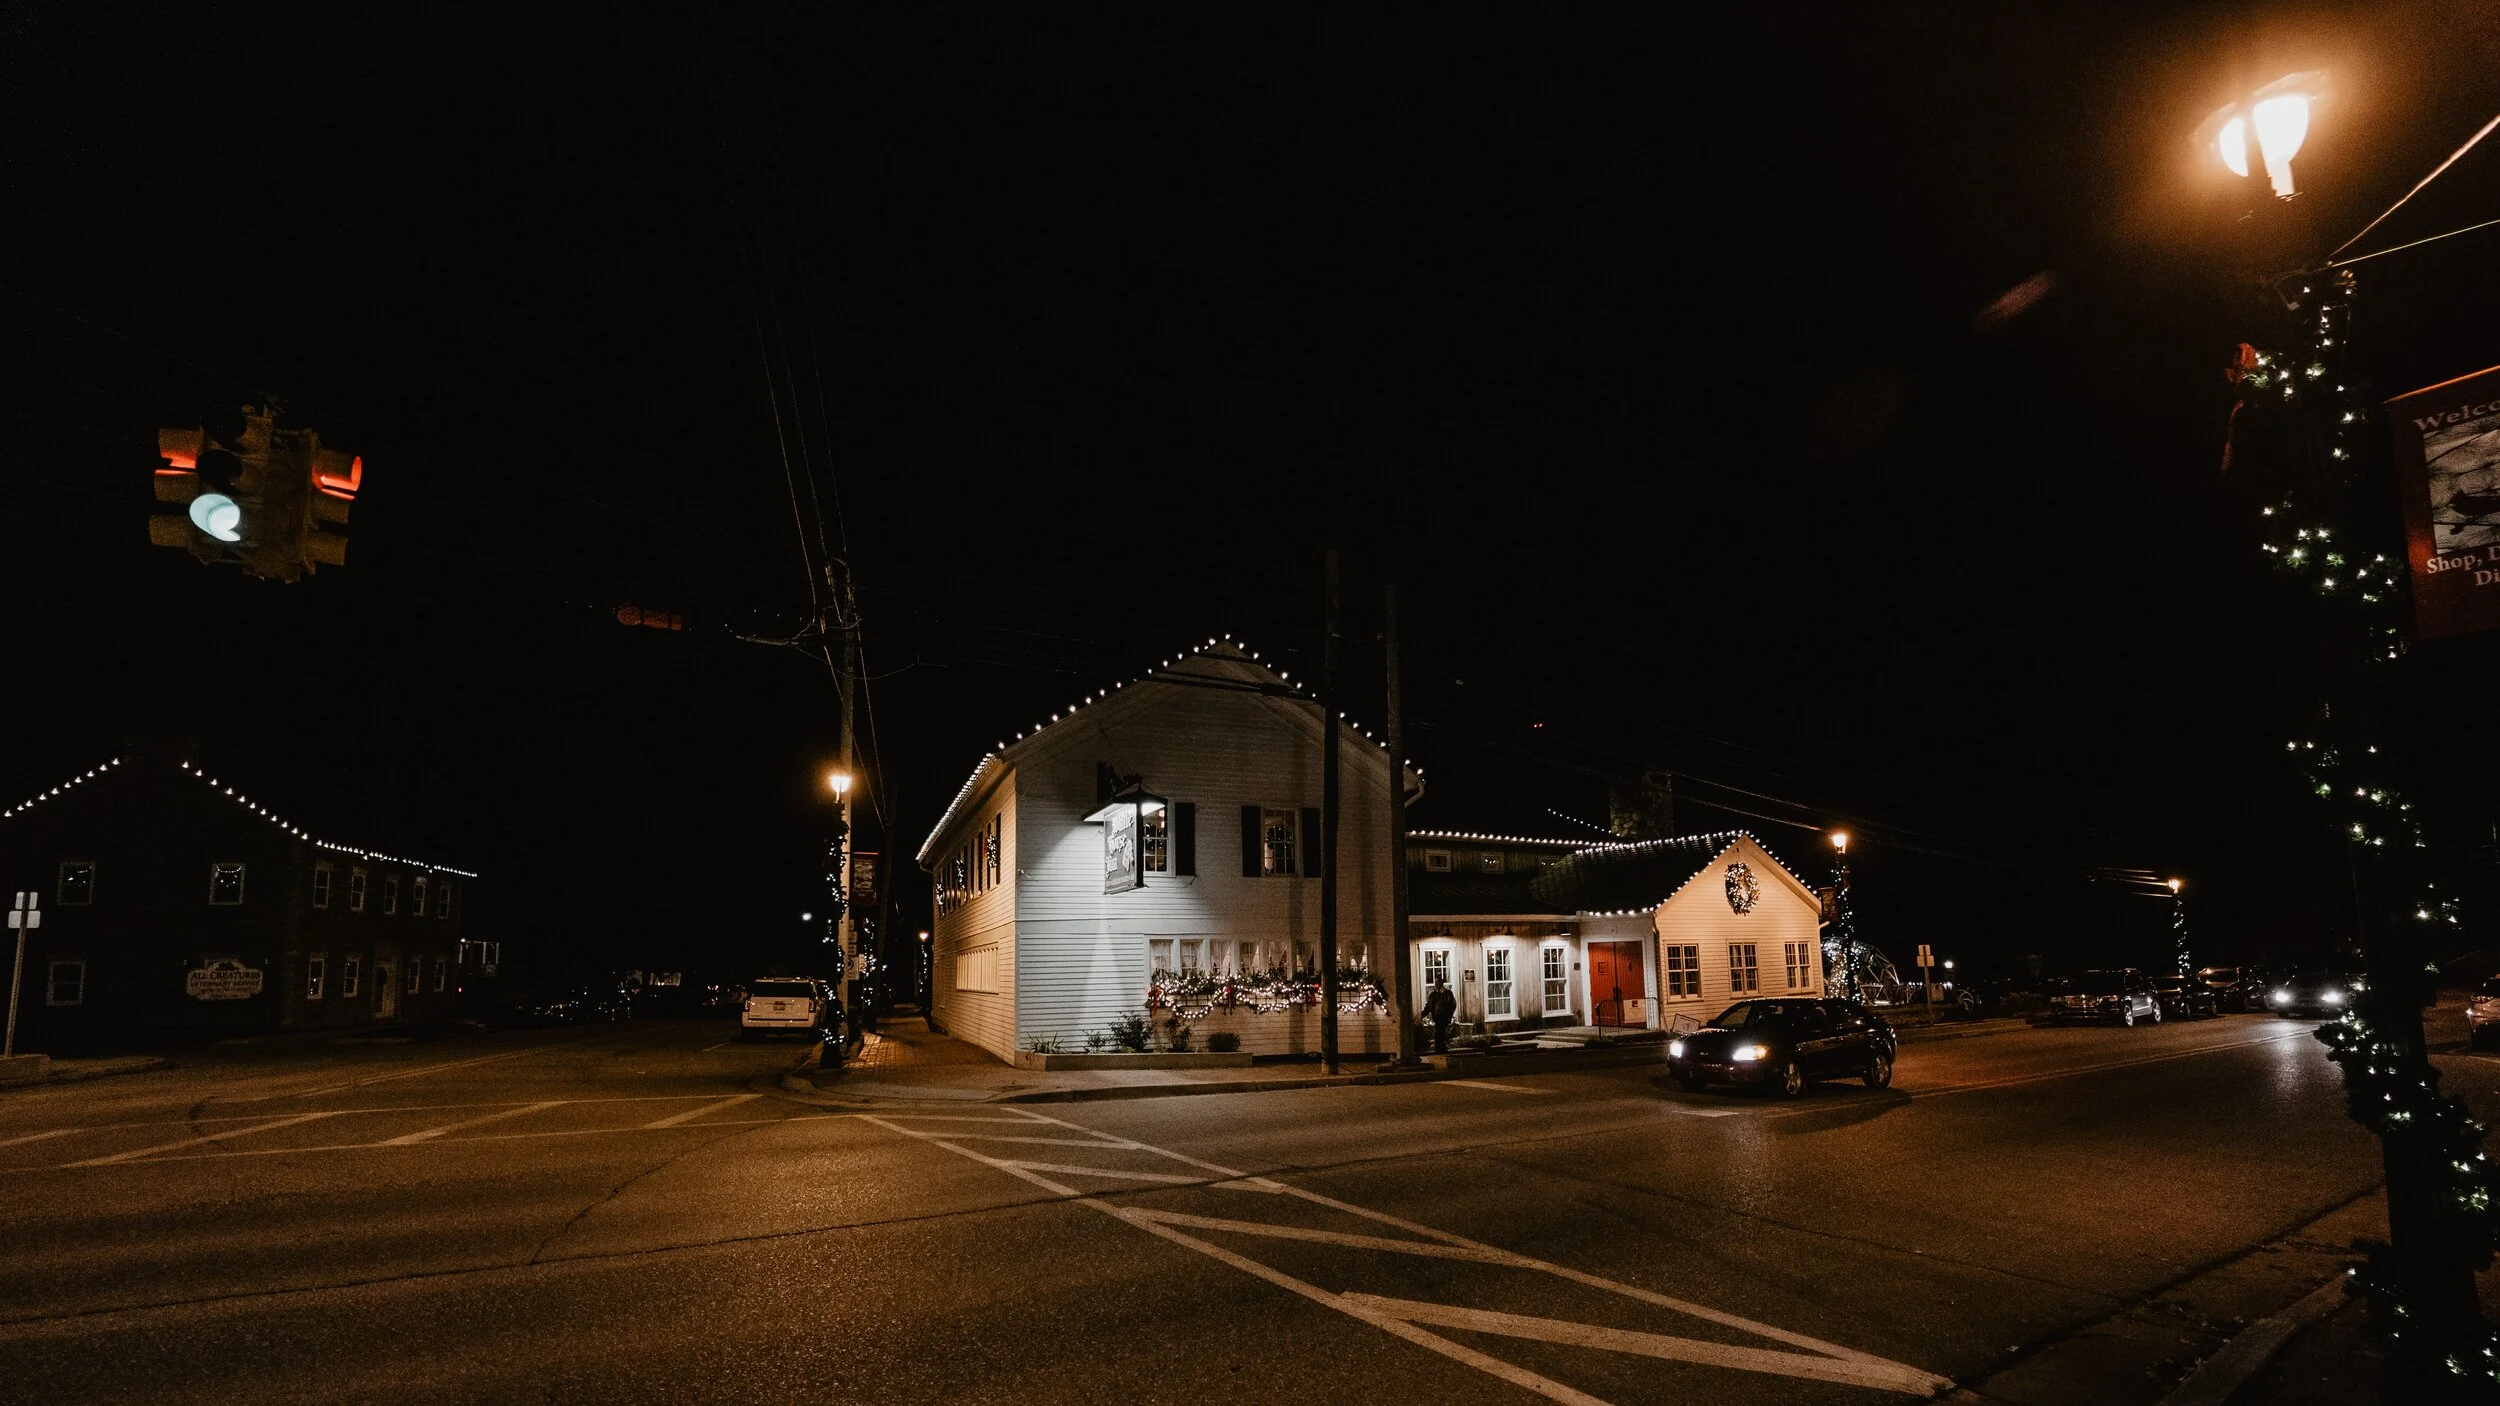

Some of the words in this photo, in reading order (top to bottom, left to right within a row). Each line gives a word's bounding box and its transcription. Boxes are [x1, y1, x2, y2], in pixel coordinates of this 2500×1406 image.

[2412, 400, 2500, 430] Welco
[2427, 554, 2483, 574] Shop,
[2474, 568, 2500, 586] Di
[191, 972, 206, 980] ALL
[209, 971, 261, 980] CREATURES
